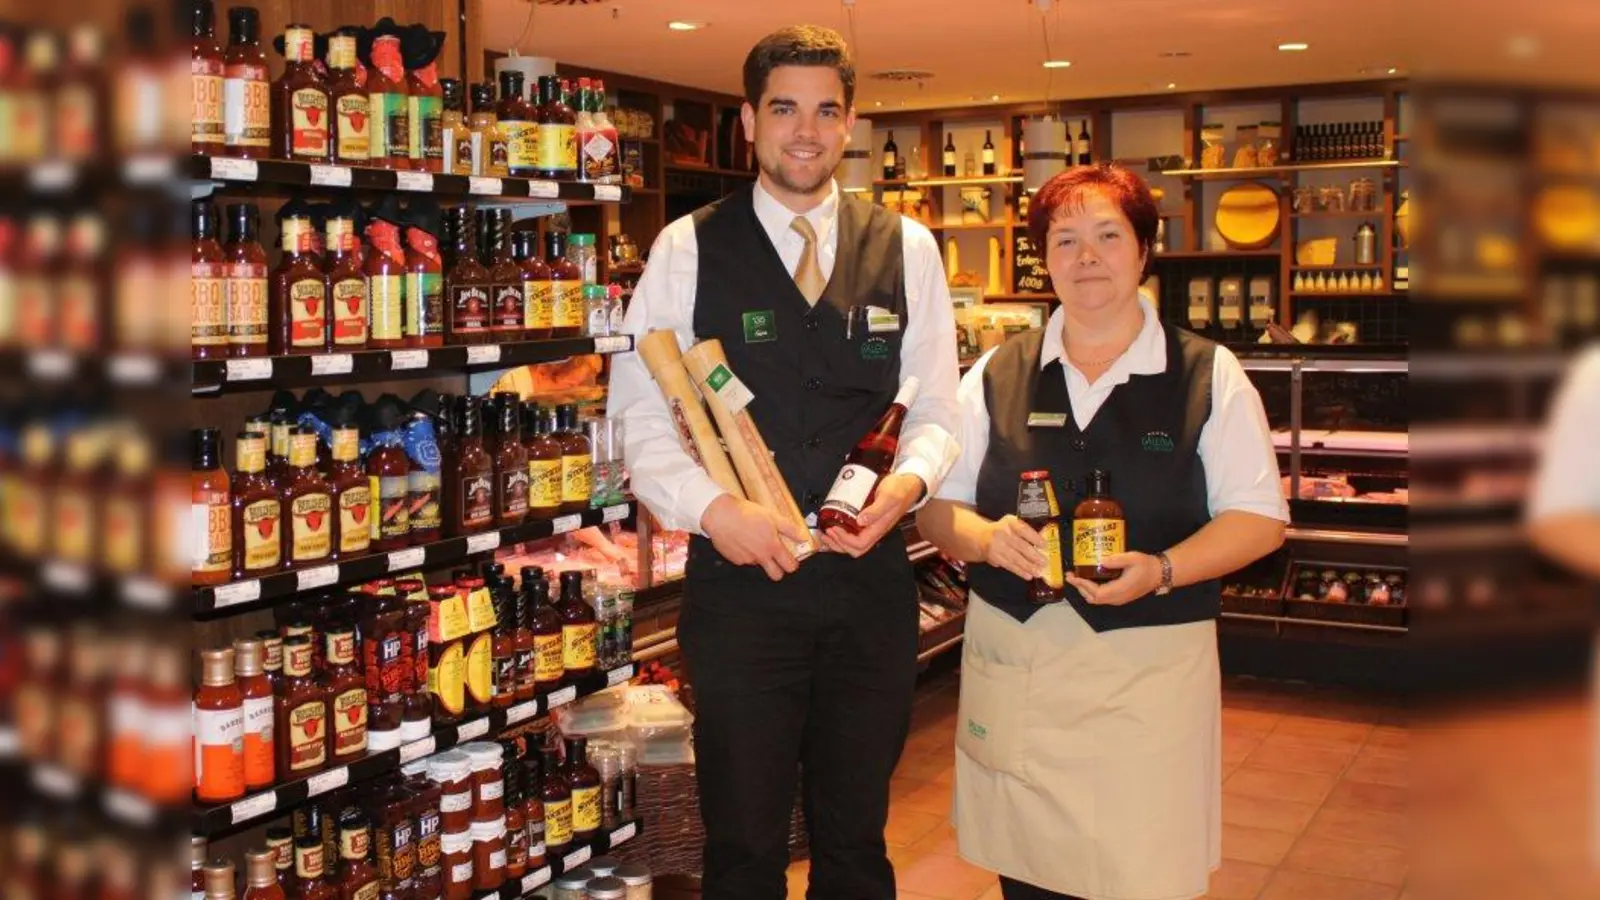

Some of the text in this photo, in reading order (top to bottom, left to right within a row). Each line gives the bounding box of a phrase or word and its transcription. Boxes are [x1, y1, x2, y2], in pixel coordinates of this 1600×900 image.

[230, 282, 260, 305] BBQ
[209, 508, 230, 532] BB
[383, 641, 401, 659] HP
[418, 631, 429, 650] H
[421, 816, 439, 836] HP
[395, 828, 411, 847] HP
